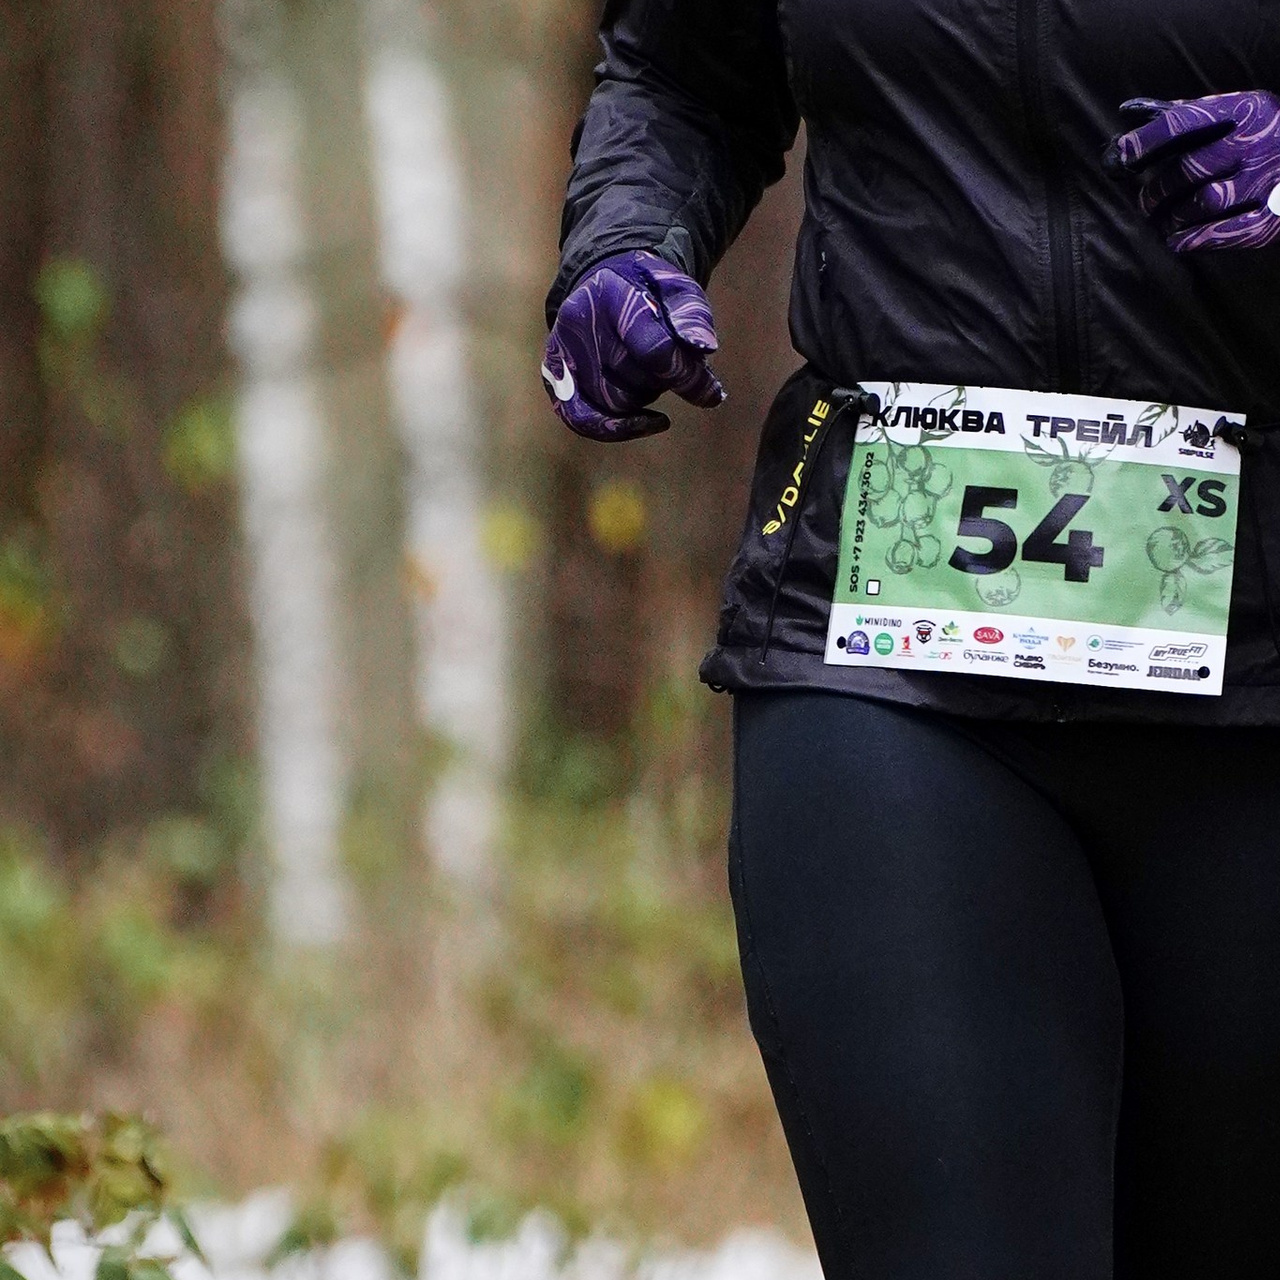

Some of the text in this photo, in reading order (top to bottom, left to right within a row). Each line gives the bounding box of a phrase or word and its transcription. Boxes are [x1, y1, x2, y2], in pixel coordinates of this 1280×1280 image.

[871, 406, 1154, 448] КЛЮКВА ТРЕЙЛ
[1157, 474, 1228, 518] XS
[849, 451, 875, 593] SOS +7 923 434 30 02
[948, 485, 1105, 583] 54
[976, 631, 1001, 641] SAVA
